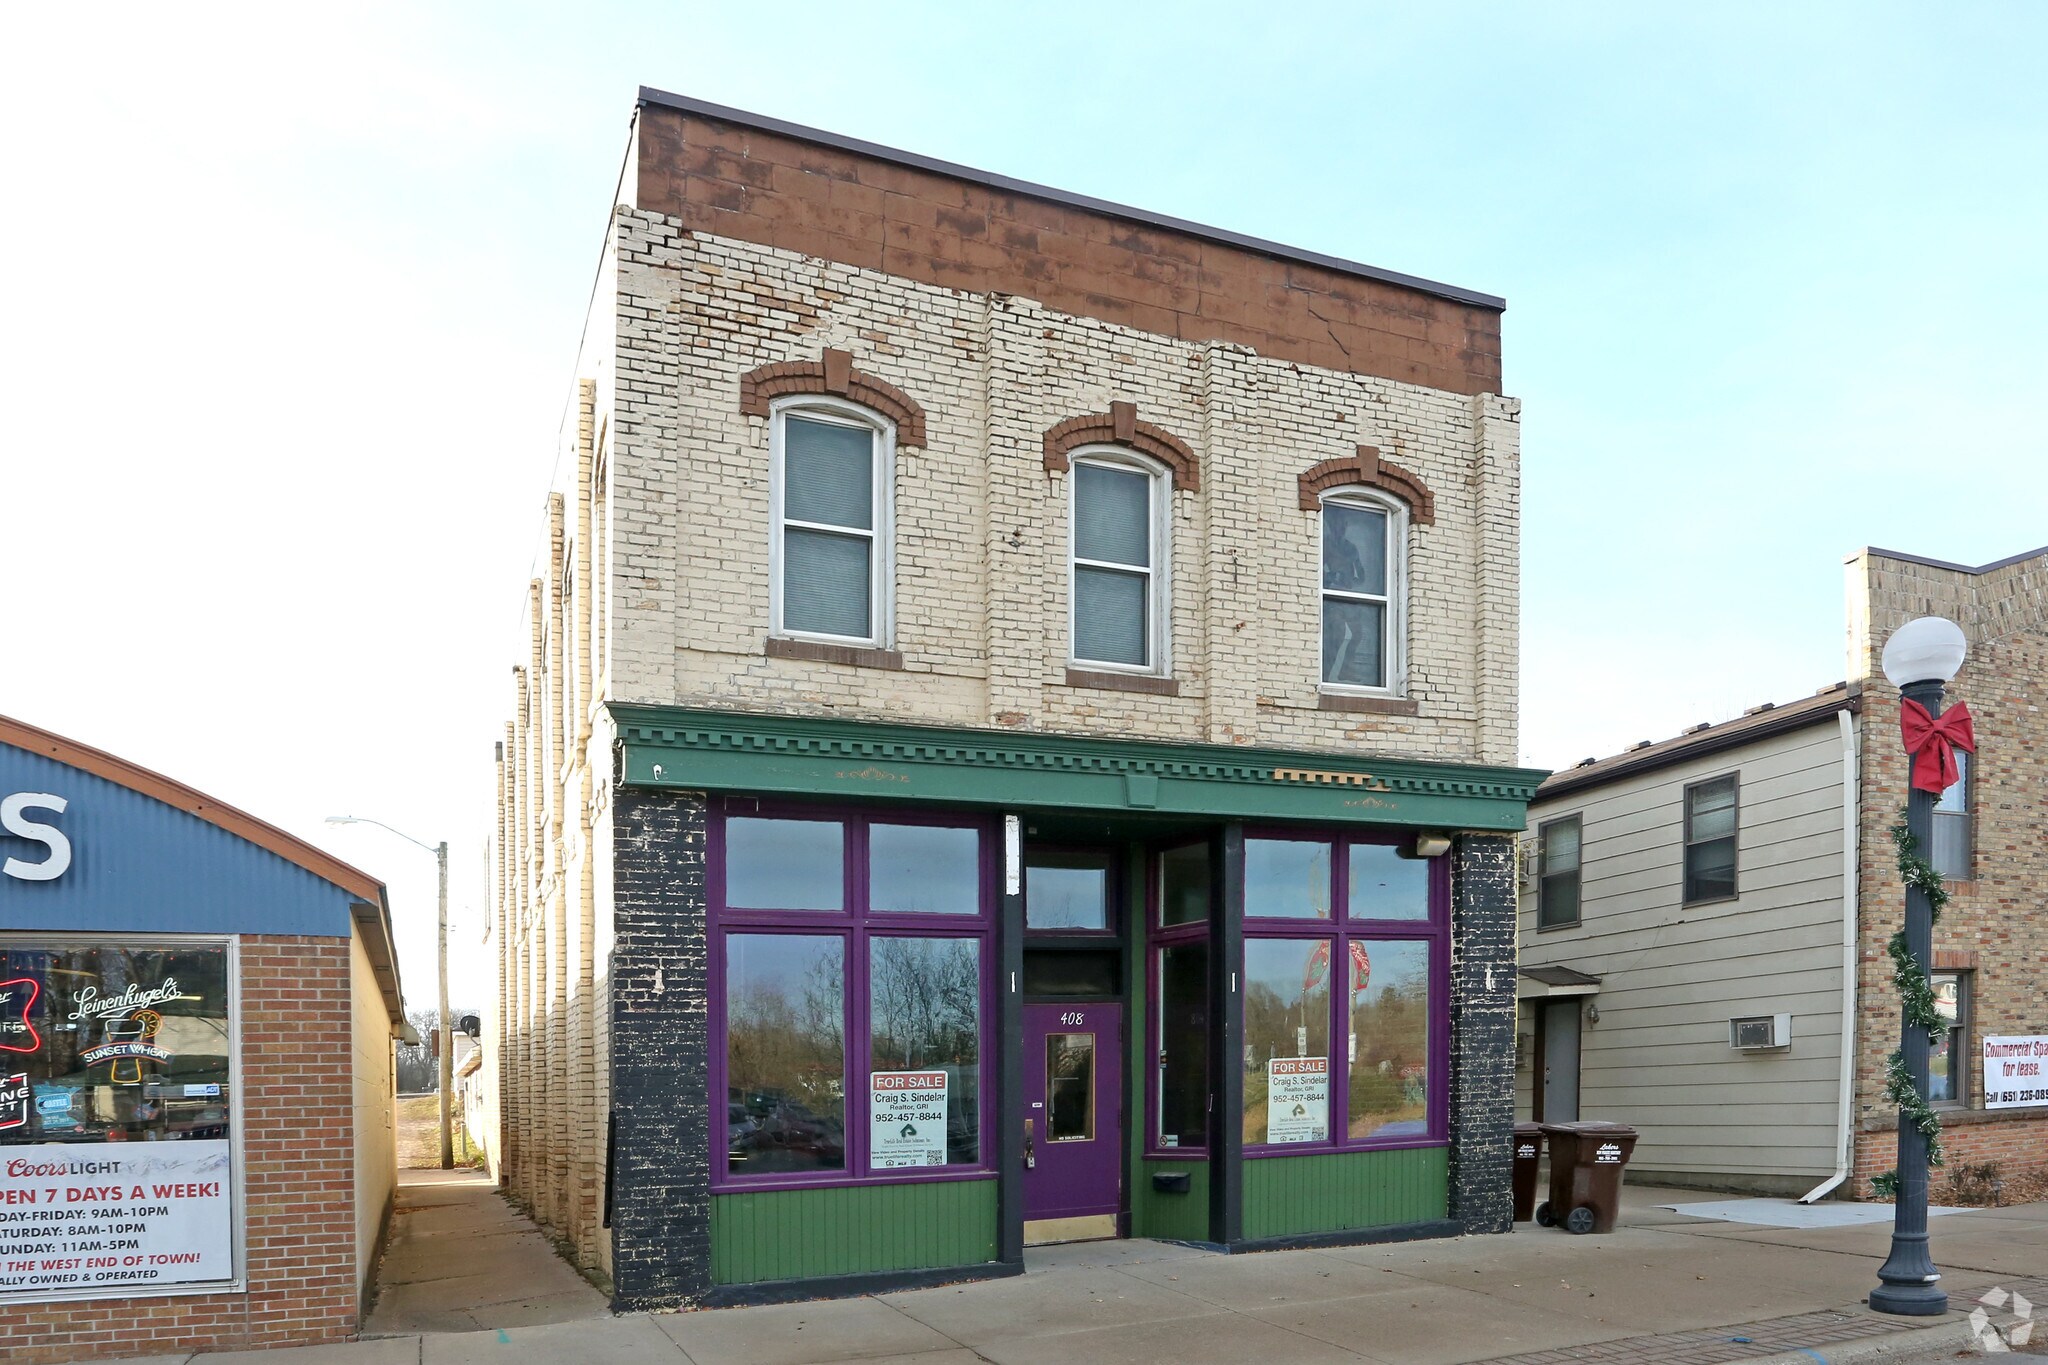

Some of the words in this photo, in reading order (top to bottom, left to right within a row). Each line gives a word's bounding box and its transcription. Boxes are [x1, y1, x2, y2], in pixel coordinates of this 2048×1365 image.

[0, 792, 72, 881] S
[68, 977, 182, 1019] Leinenkugel's
[1060, 1012, 1085, 1025] 408
[84, 1045, 128, 1063] SUNSET
[129, 1043, 172, 1060] WHEAT
[1985, 1041, 2033, 1058] Commercial
[1273, 1062, 1296, 1073] FOR
[1298, 1061, 1325, 1072] SALE
[2002, 1061, 2016, 1077] for
[2016, 1060, 2040, 1077] lease.
[876, 1077, 904, 1088] FOR
[908, 1076, 943, 1088] SALE
[1273, 1077, 1291, 1088] Craig
[1300, 1076, 1328, 1085] Sindelar
[875, 1093, 899, 1104] Craig
[900, 1092, 909, 1102] S.
[911, 1092, 946, 1102] Sindelar
[1273, 1093, 1325, 1103] 952-457-8844
[1985, 1091, 1999, 1103] Call
[2000, 1090, 2018, 1103] (651)
[875, 1112, 942, 1123] 952-457-8844
[6, 1158, 69, 1178] Coors
[70, 1161, 121, 1175] LIGHT
[45, 1188, 58, 1203] 7
[66, 1186, 123, 1202] DAYS
[129, 1185, 146, 1200] A
[152, 1182, 219, 1199] WEEK!
[91, 1206, 169, 1219] 9AM-10PM
[0, 1226, 63, 1239] TURDAY:
[68, 1223, 146, 1236] 8AM-10PM
[0, 1243, 56, 1255] UNDAY:
[62, 1239, 139, 1252] 11AM-5PM
[7, 1260, 36, 1272] THE
[41, 1258, 82, 1270] WEST
[86, 1256, 118, 1268] END
[122, 1255, 144, 1267] OF
[148, 1253, 201, 1265] TOWN!
[29, 1273, 78, 1285] OWNED
[82, 1273, 91, 1282] &
[95, 1269, 158, 1281] OPERATED
